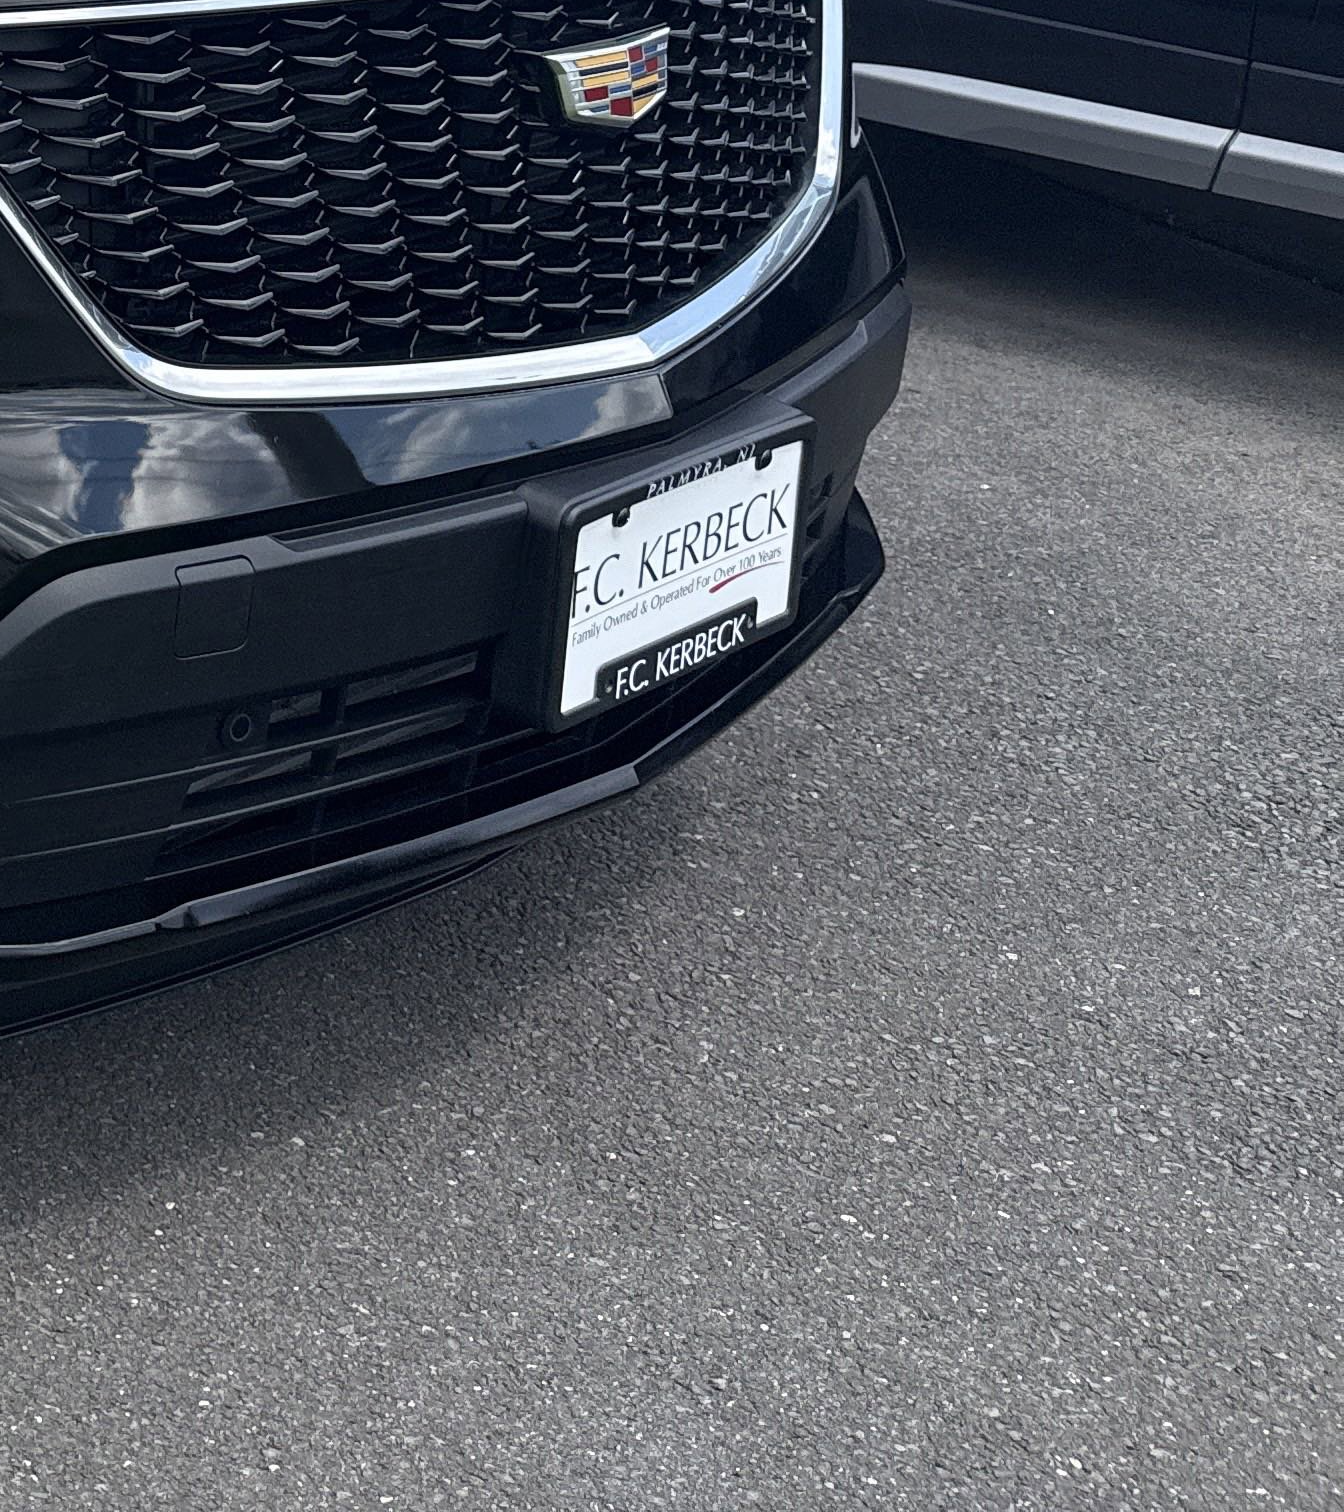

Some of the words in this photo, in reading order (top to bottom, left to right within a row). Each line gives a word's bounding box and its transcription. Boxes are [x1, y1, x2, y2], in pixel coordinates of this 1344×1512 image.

[572, 553, 625, 619] F.C.
[638, 483, 791, 589] KERBECK
[572, 622, 601, 647] Family
[603, 602, 638, 631] Owned
[640, 600, 649, 614] &
[650, 578, 694, 610] Operated
[696, 575, 711, 590] For
[713, 564, 736, 582] Over
[739, 554, 755, 570] 100
[758, 547, 782, 563] Years
[615, 659, 649, 699] F.C.
[656, 613, 747, 681] KERBECK
